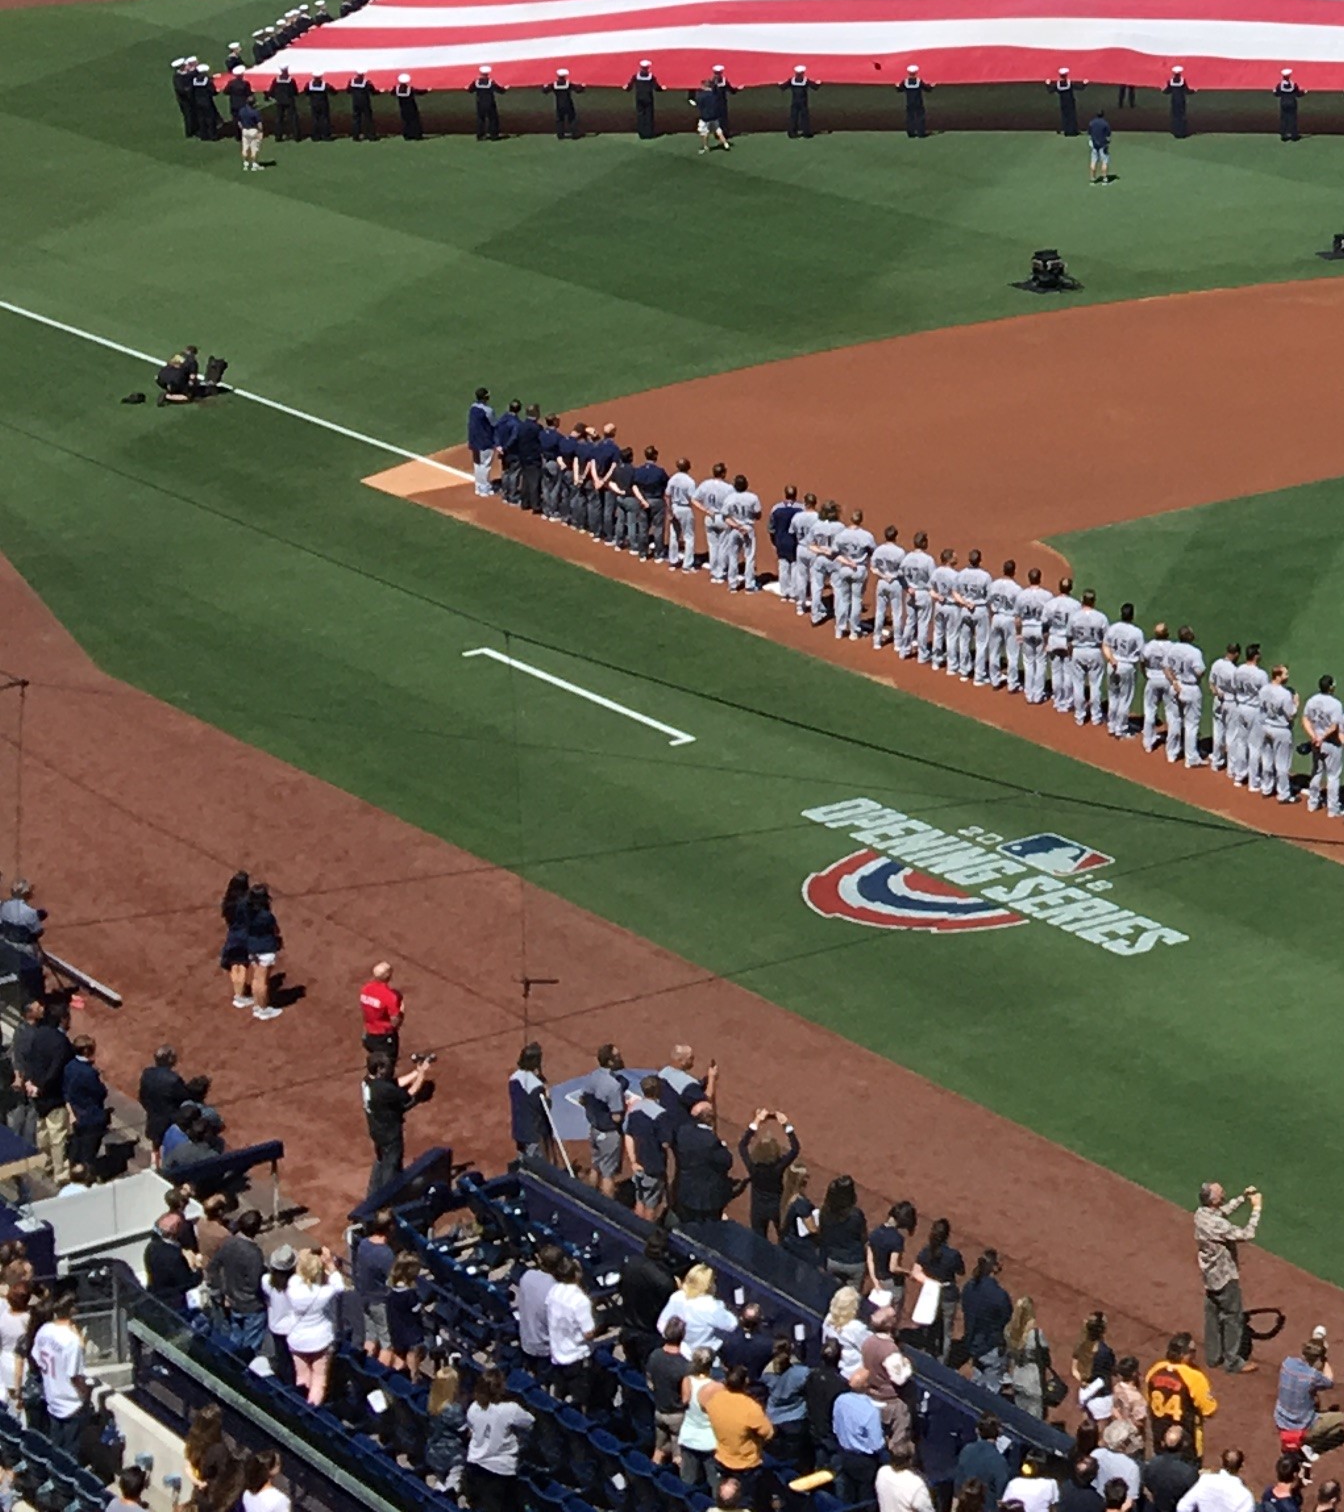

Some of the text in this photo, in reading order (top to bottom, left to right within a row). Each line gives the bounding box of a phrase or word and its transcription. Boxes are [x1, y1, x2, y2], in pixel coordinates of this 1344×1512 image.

[800, 796, 1191, 957] OPENING SERIES
[40, 1349, 57, 1380] 51
